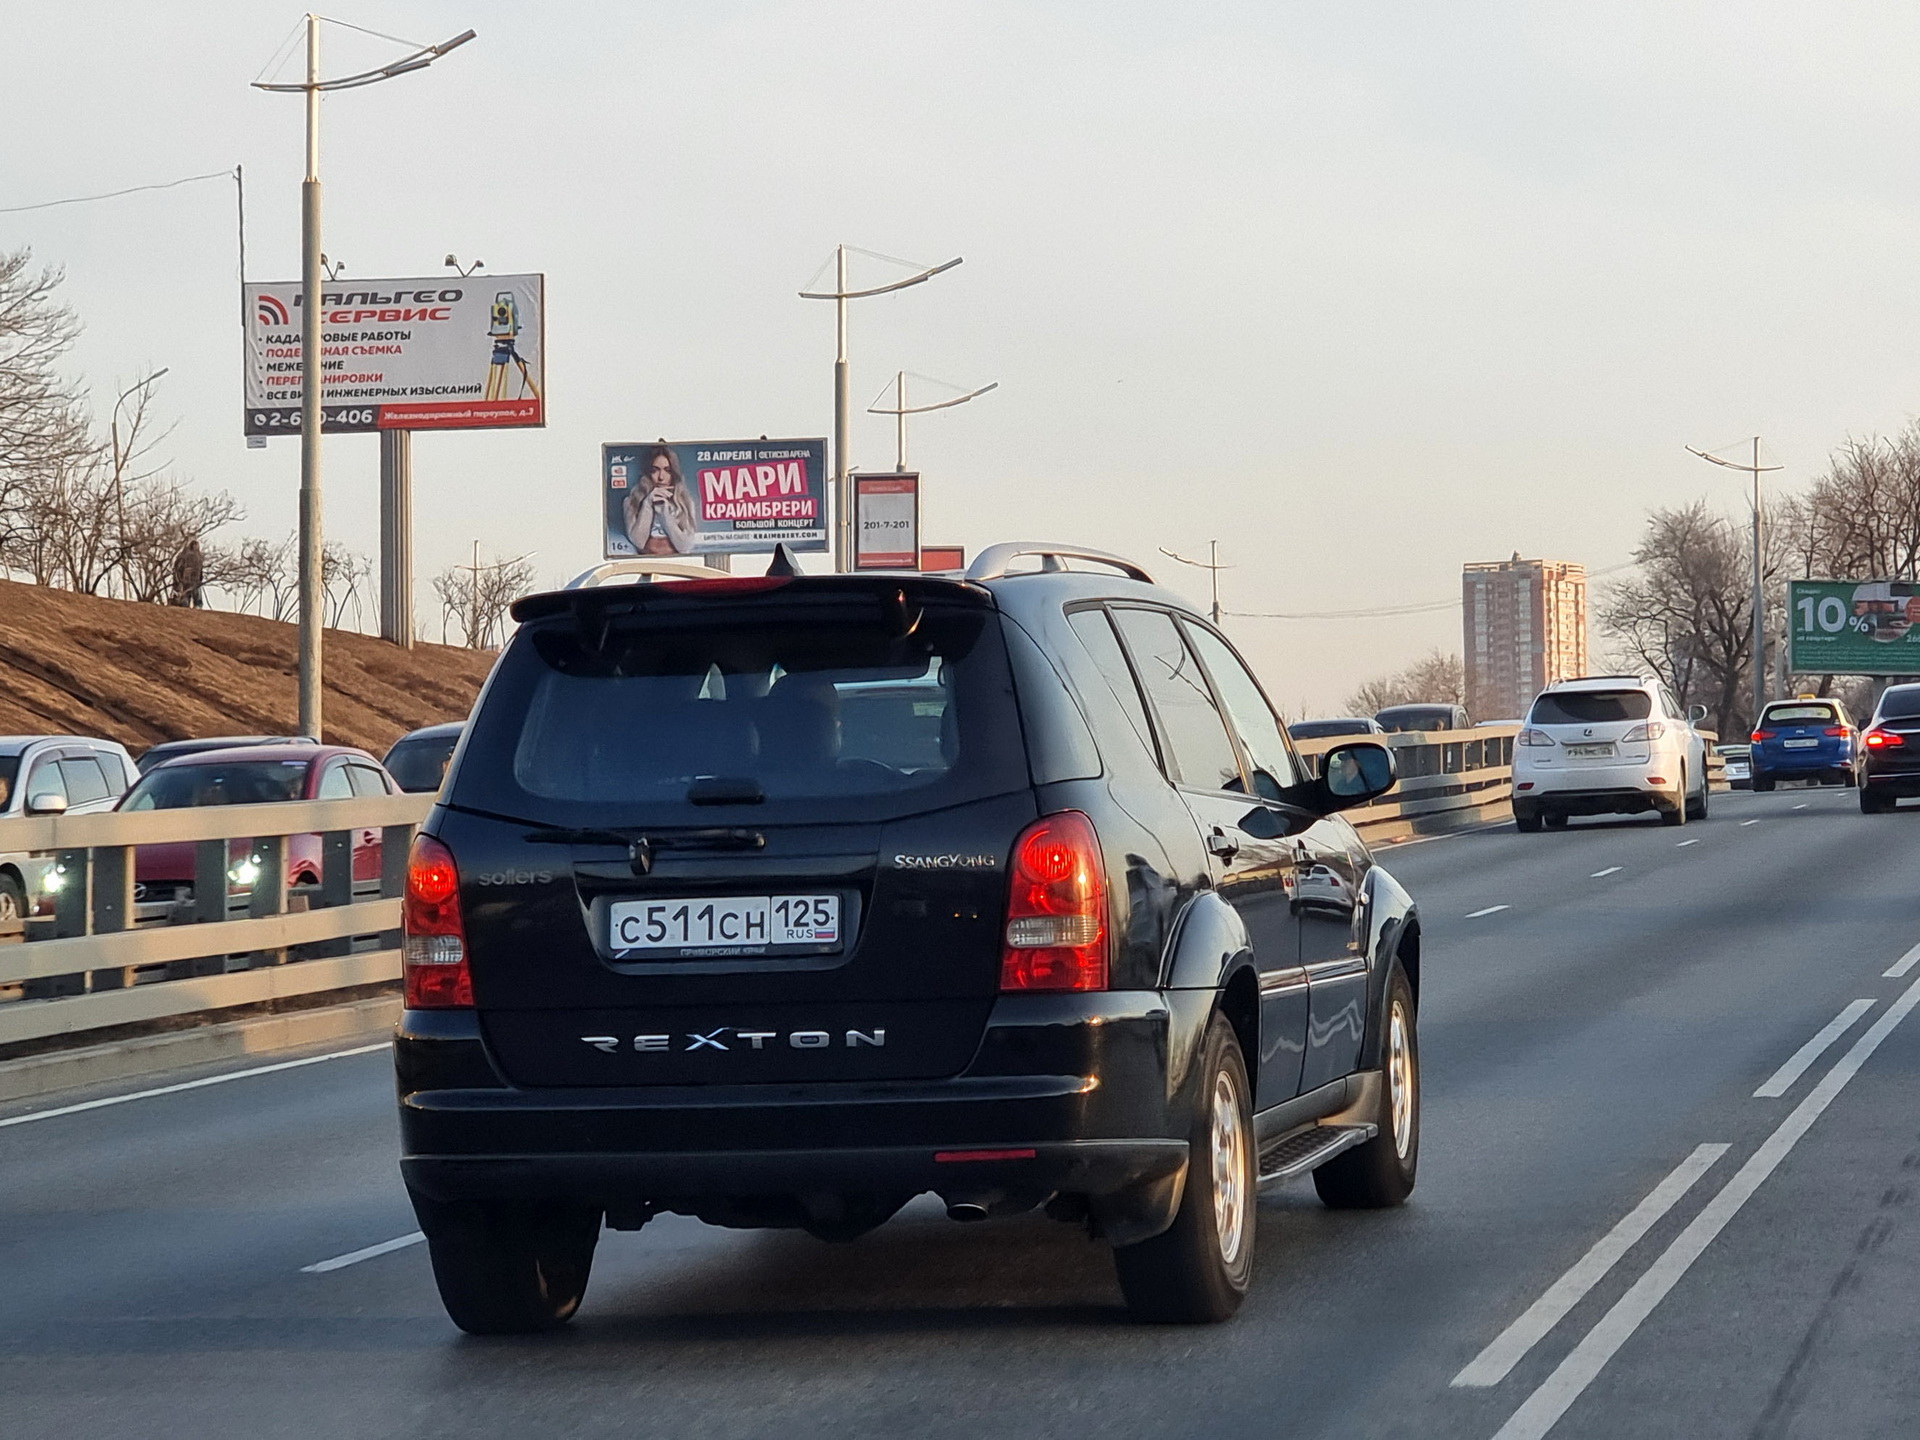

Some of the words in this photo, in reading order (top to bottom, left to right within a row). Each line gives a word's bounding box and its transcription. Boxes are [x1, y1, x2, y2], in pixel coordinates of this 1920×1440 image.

[361, 331, 411, 342] РАБОТЫ
[351, 345, 402, 355] СЪЕМКА
[266, 361, 344, 372] МЕЖЕНИЕ
[266, 391, 288, 400] ВСЕ
[326, 387, 407, 398] ИНЖЕНЕРНЫХ
[410, 383, 482, 396] ИЗЫСКАНИЙ
[697, 451, 711, 461] 28
[713, 450, 752, 460] АПРЕЛЯ
[703, 462, 802, 502] МАРИ
[705, 500, 812, 519] КРАЙМБРЕРИ
[735, 519, 775, 528] БОЛЬШОЙ
[778, 518, 814, 528] КОНЦЕРТ
[863, 520, 910, 530] 201-7-201
[612, 542, 628, 550] 16+
[478, 868, 552, 886] sollers
[774, 899, 830, 928] 125
[786, 929, 813, 939] RUS
[580, 1027, 885, 1053] REXTON
